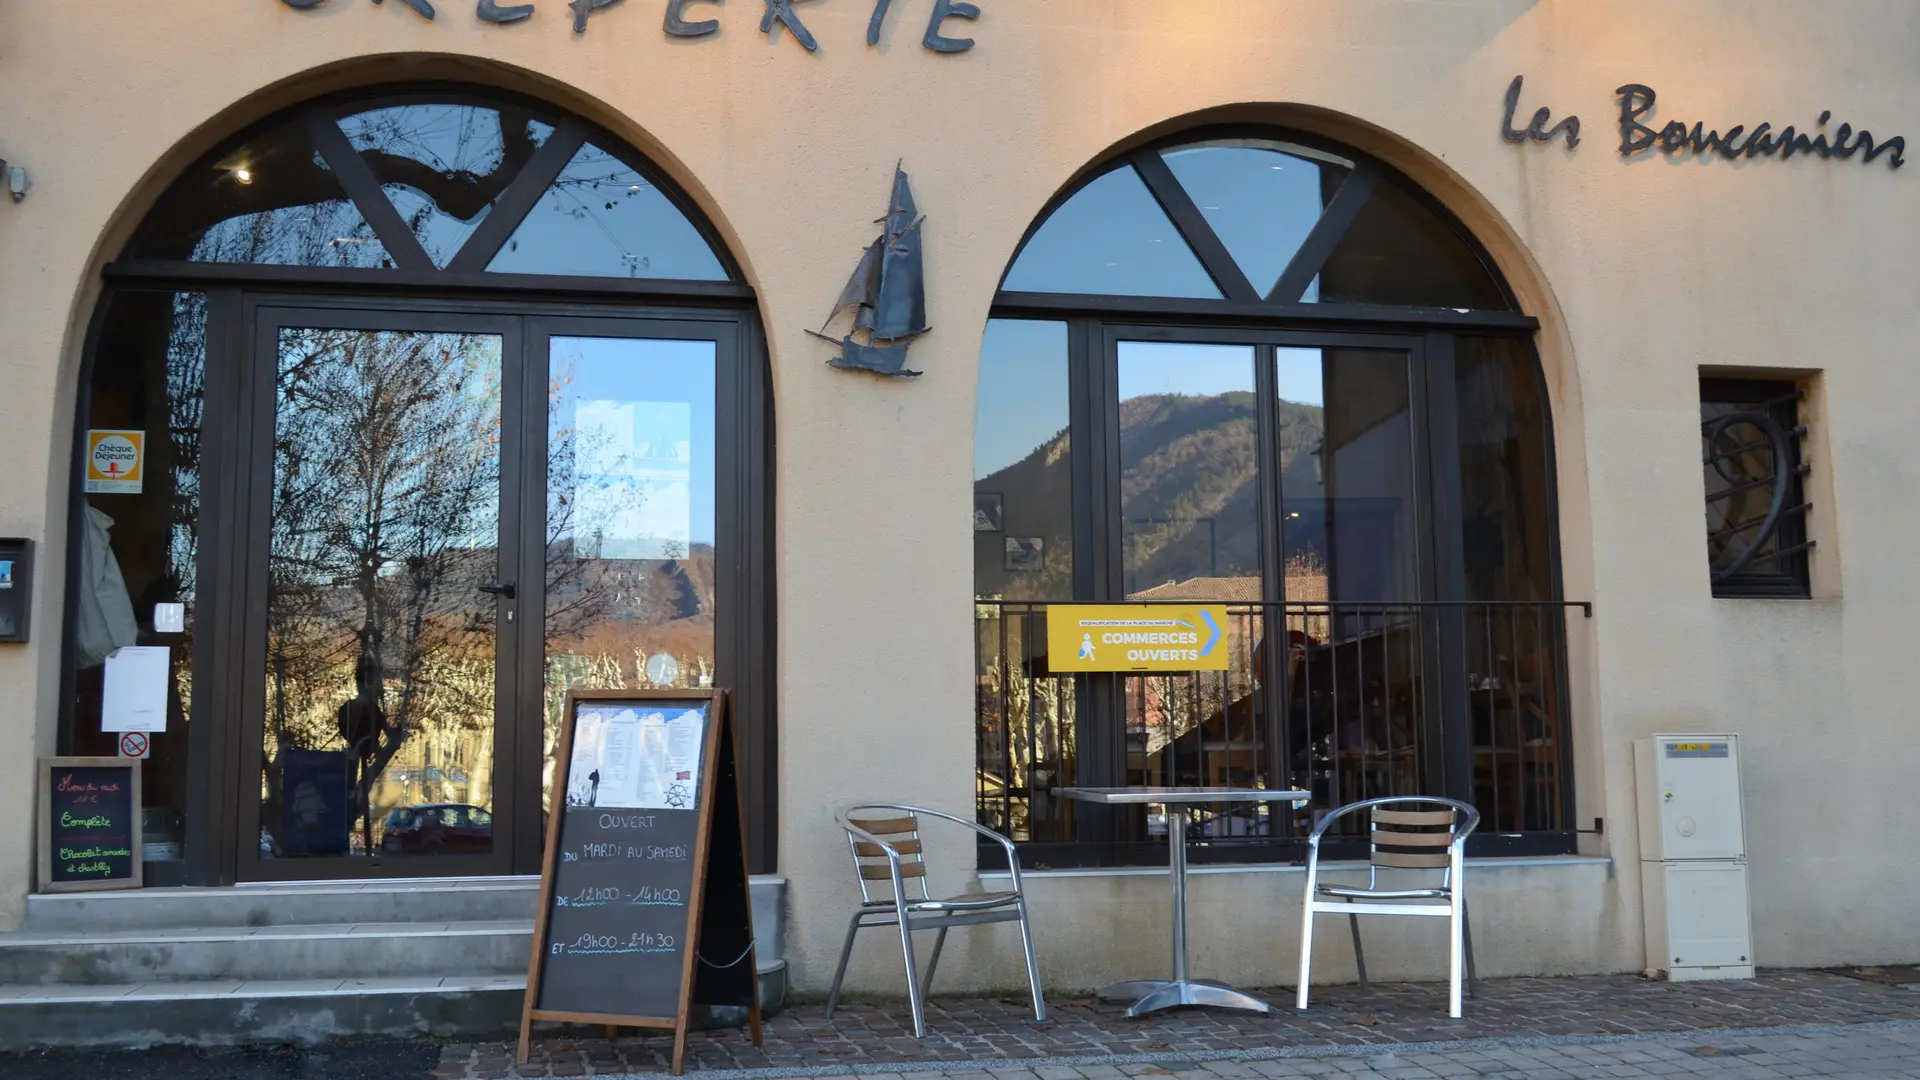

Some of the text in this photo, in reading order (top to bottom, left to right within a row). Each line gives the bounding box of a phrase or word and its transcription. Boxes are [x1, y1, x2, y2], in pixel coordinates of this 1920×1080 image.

[1502, 74, 1906, 170] Les Boucaniers
[1102, 632, 1198, 644] COMMERCES
[1127, 649, 1198, 661] OUVERTS
[599, 814, 656, 829] OUVERT
[60, 847, 101, 859] Chocolat
[564, 852, 578, 862] DU
[627, 846, 643, 859] AU
[557, 896, 569, 907] DE
[573, 887, 619, 901] 12h00
[632, 886, 680, 902] 14h00
[552, 943, 565, 954] ET
[569, 933, 618, 949] 19h00
